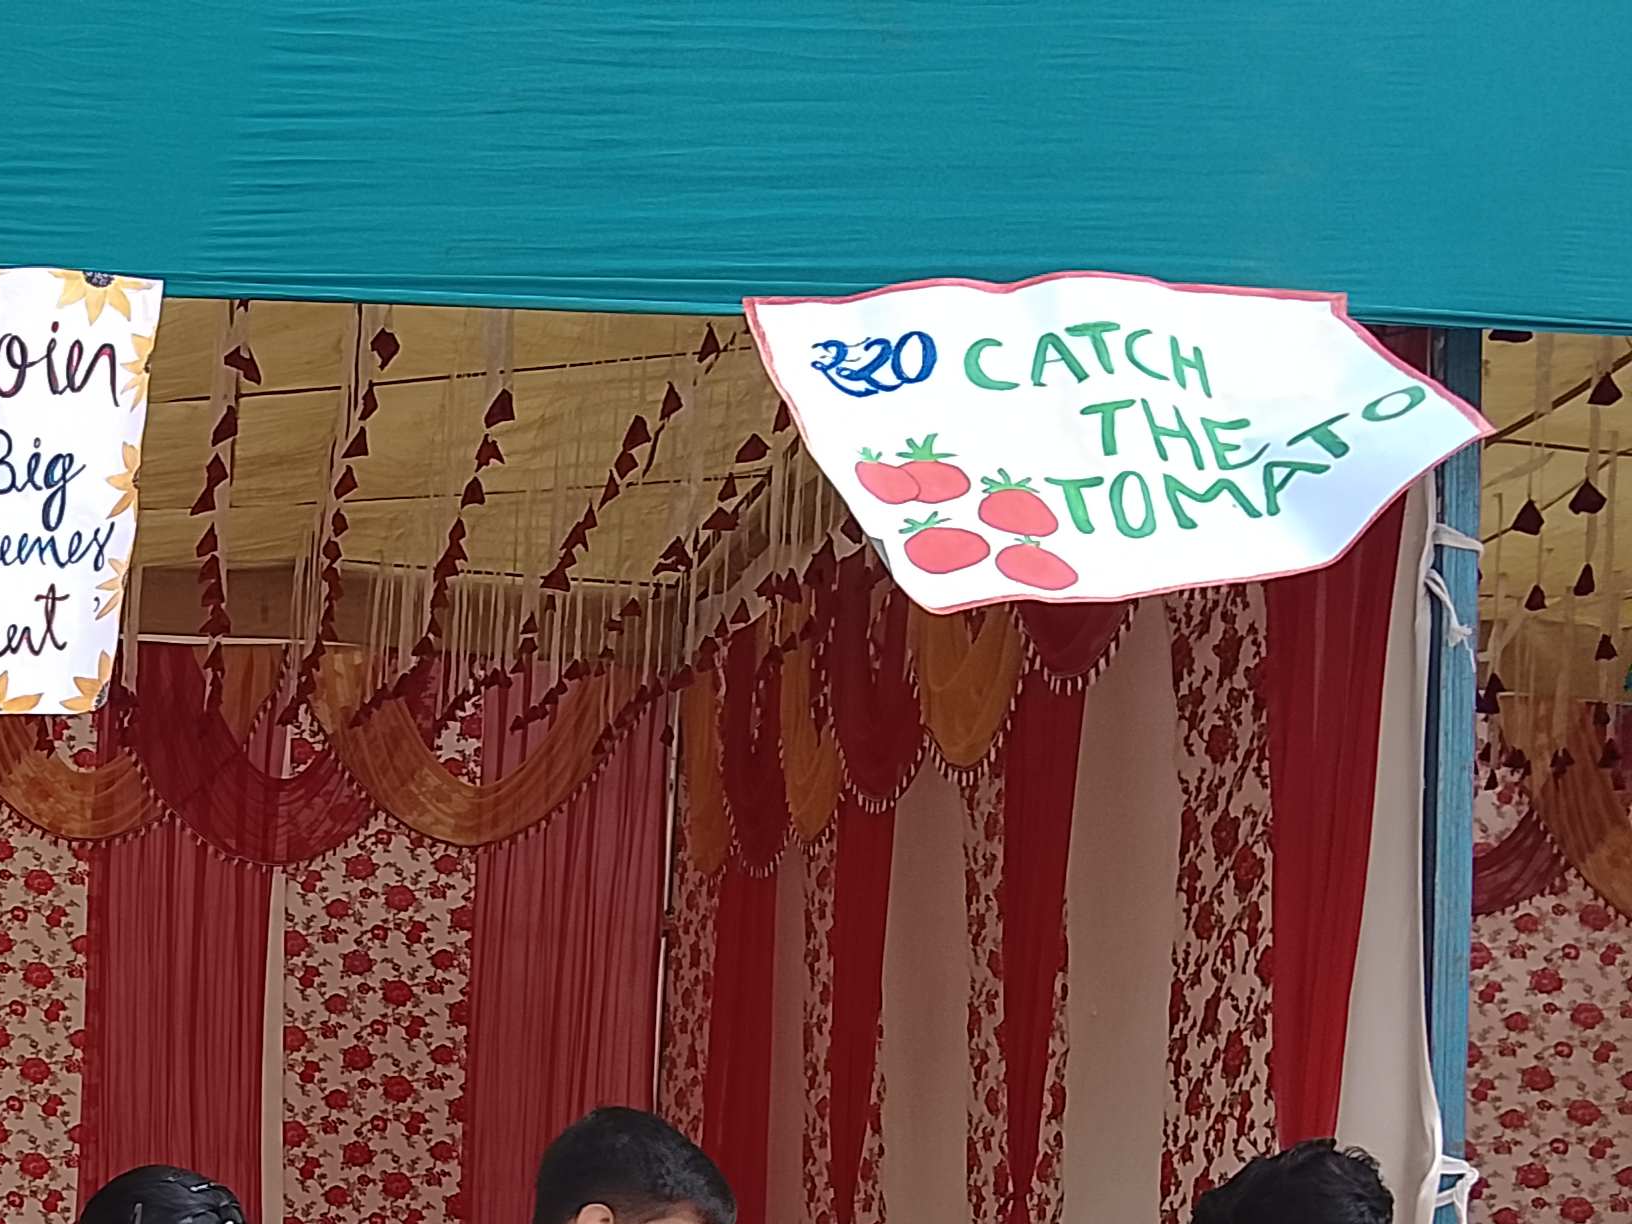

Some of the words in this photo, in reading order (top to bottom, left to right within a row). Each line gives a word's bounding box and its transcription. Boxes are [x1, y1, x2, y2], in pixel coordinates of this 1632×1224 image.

[964, 320, 1213, 399] CATCH
[1045, 386, 1427, 538] TOMATO
[1079, 398, 1270, 471] THE
